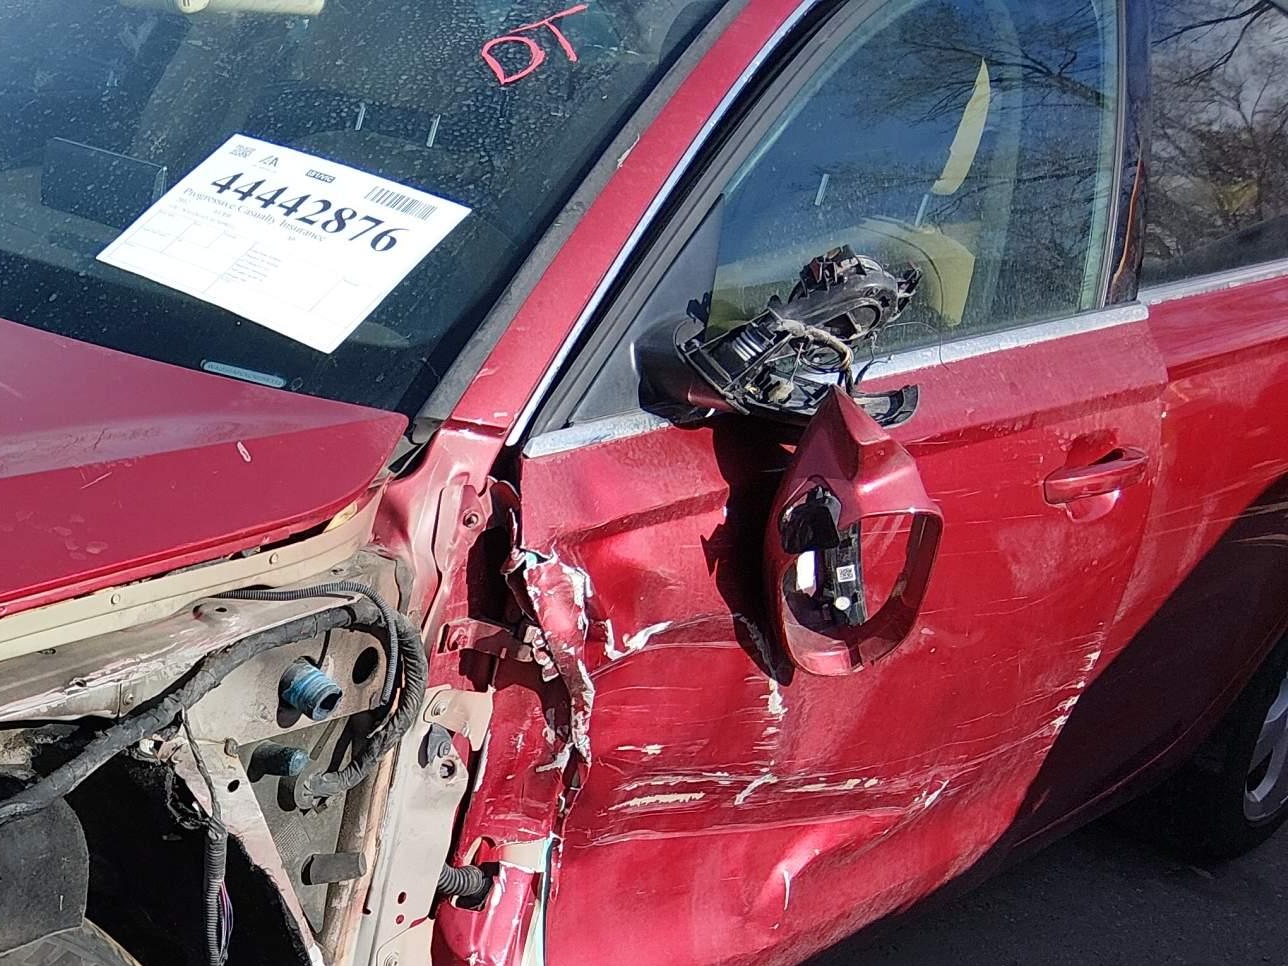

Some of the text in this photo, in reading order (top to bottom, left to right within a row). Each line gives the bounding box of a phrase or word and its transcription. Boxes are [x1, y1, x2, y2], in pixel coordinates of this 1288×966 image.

[481, 3, 589, 85] DT
[183, 187, 237, 211] Progressive
[237, 204, 276, 225] Casualty
[279, 218, 327, 242] Insurance
[210, 172, 411, 252] 44442876
